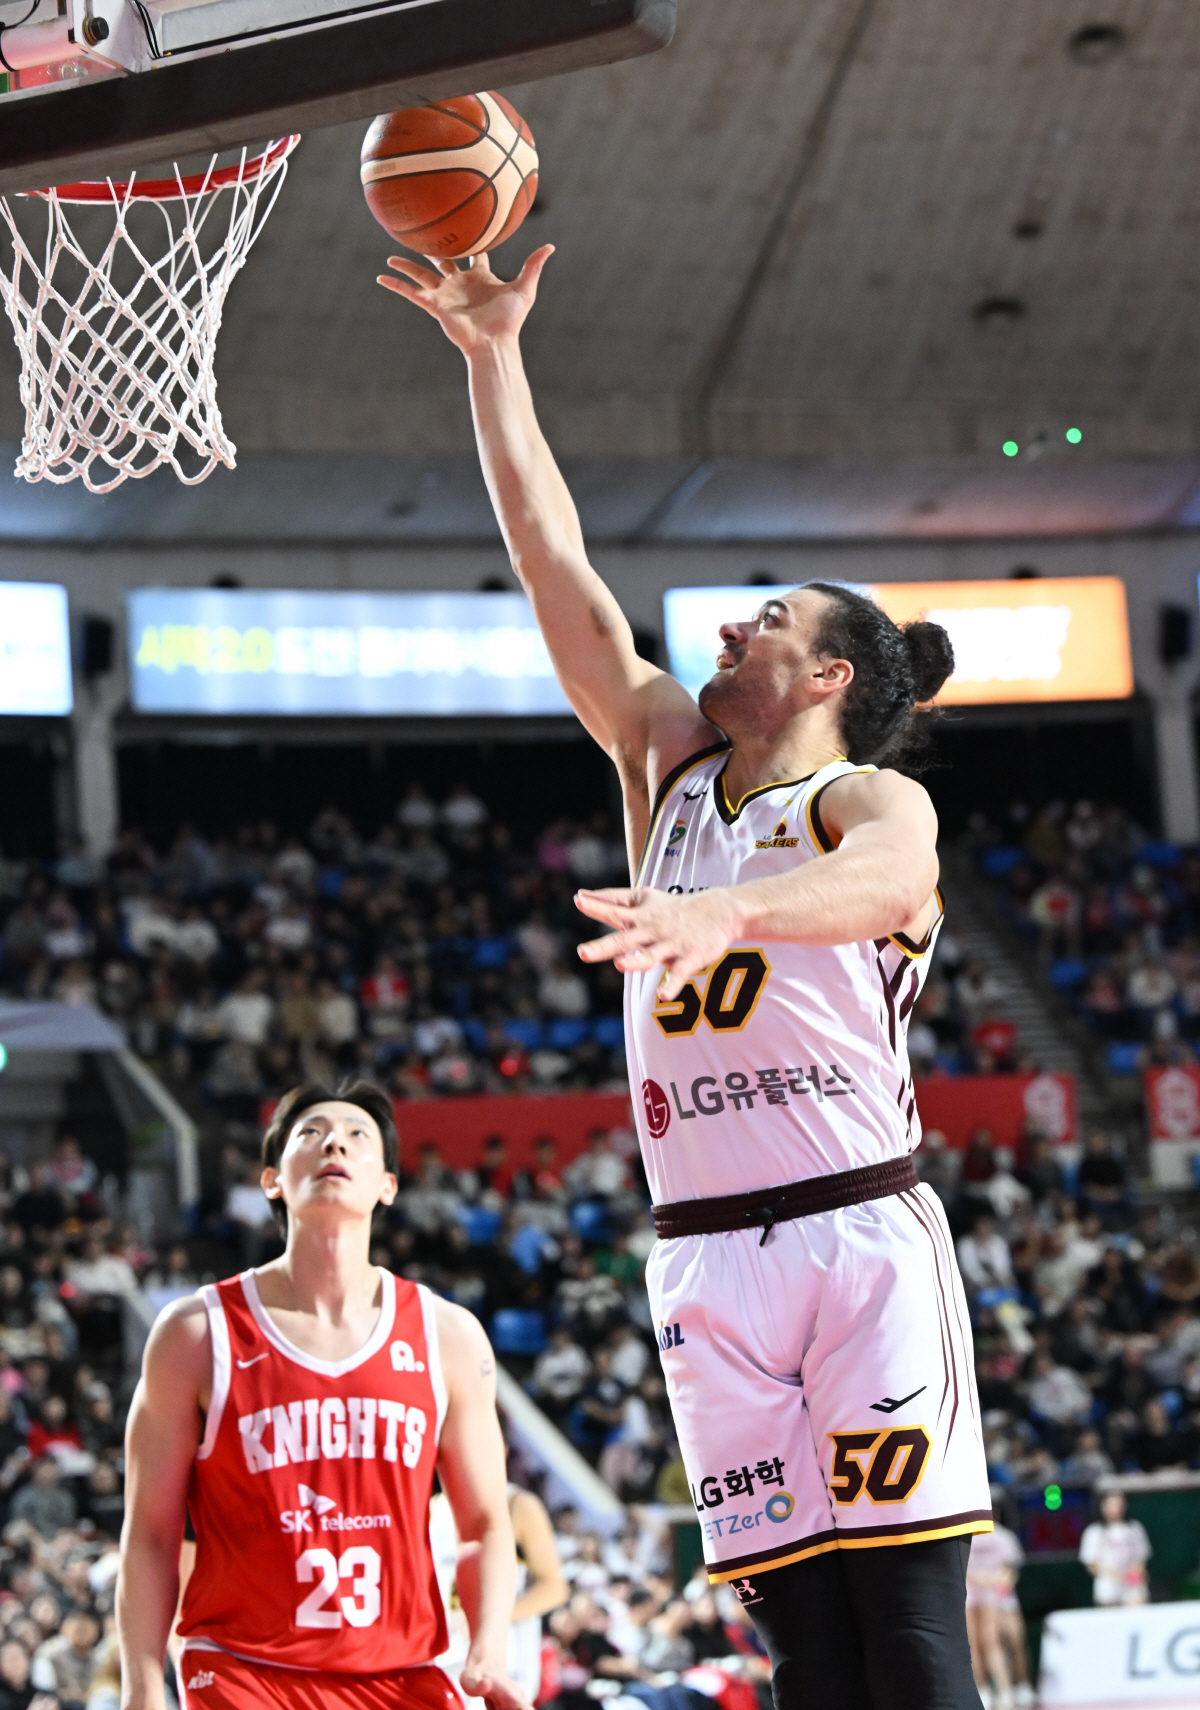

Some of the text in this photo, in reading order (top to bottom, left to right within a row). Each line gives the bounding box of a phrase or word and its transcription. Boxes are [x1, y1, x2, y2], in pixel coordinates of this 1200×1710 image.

[754, 837, 799, 849] SAKERS
[651, 947, 772, 1038] 50
[670, 1064, 856, 1120] LG유플러스
[238, 1396, 427, 1475] KNIGHTS
[691, 1456, 785, 1512] LG화학
[825, 1423, 933, 1507] 50
[280, 1509, 391, 1533] SK telecom
[295, 1545, 381, 1629] 23
[1127, 1625, 1200, 1679] LG
